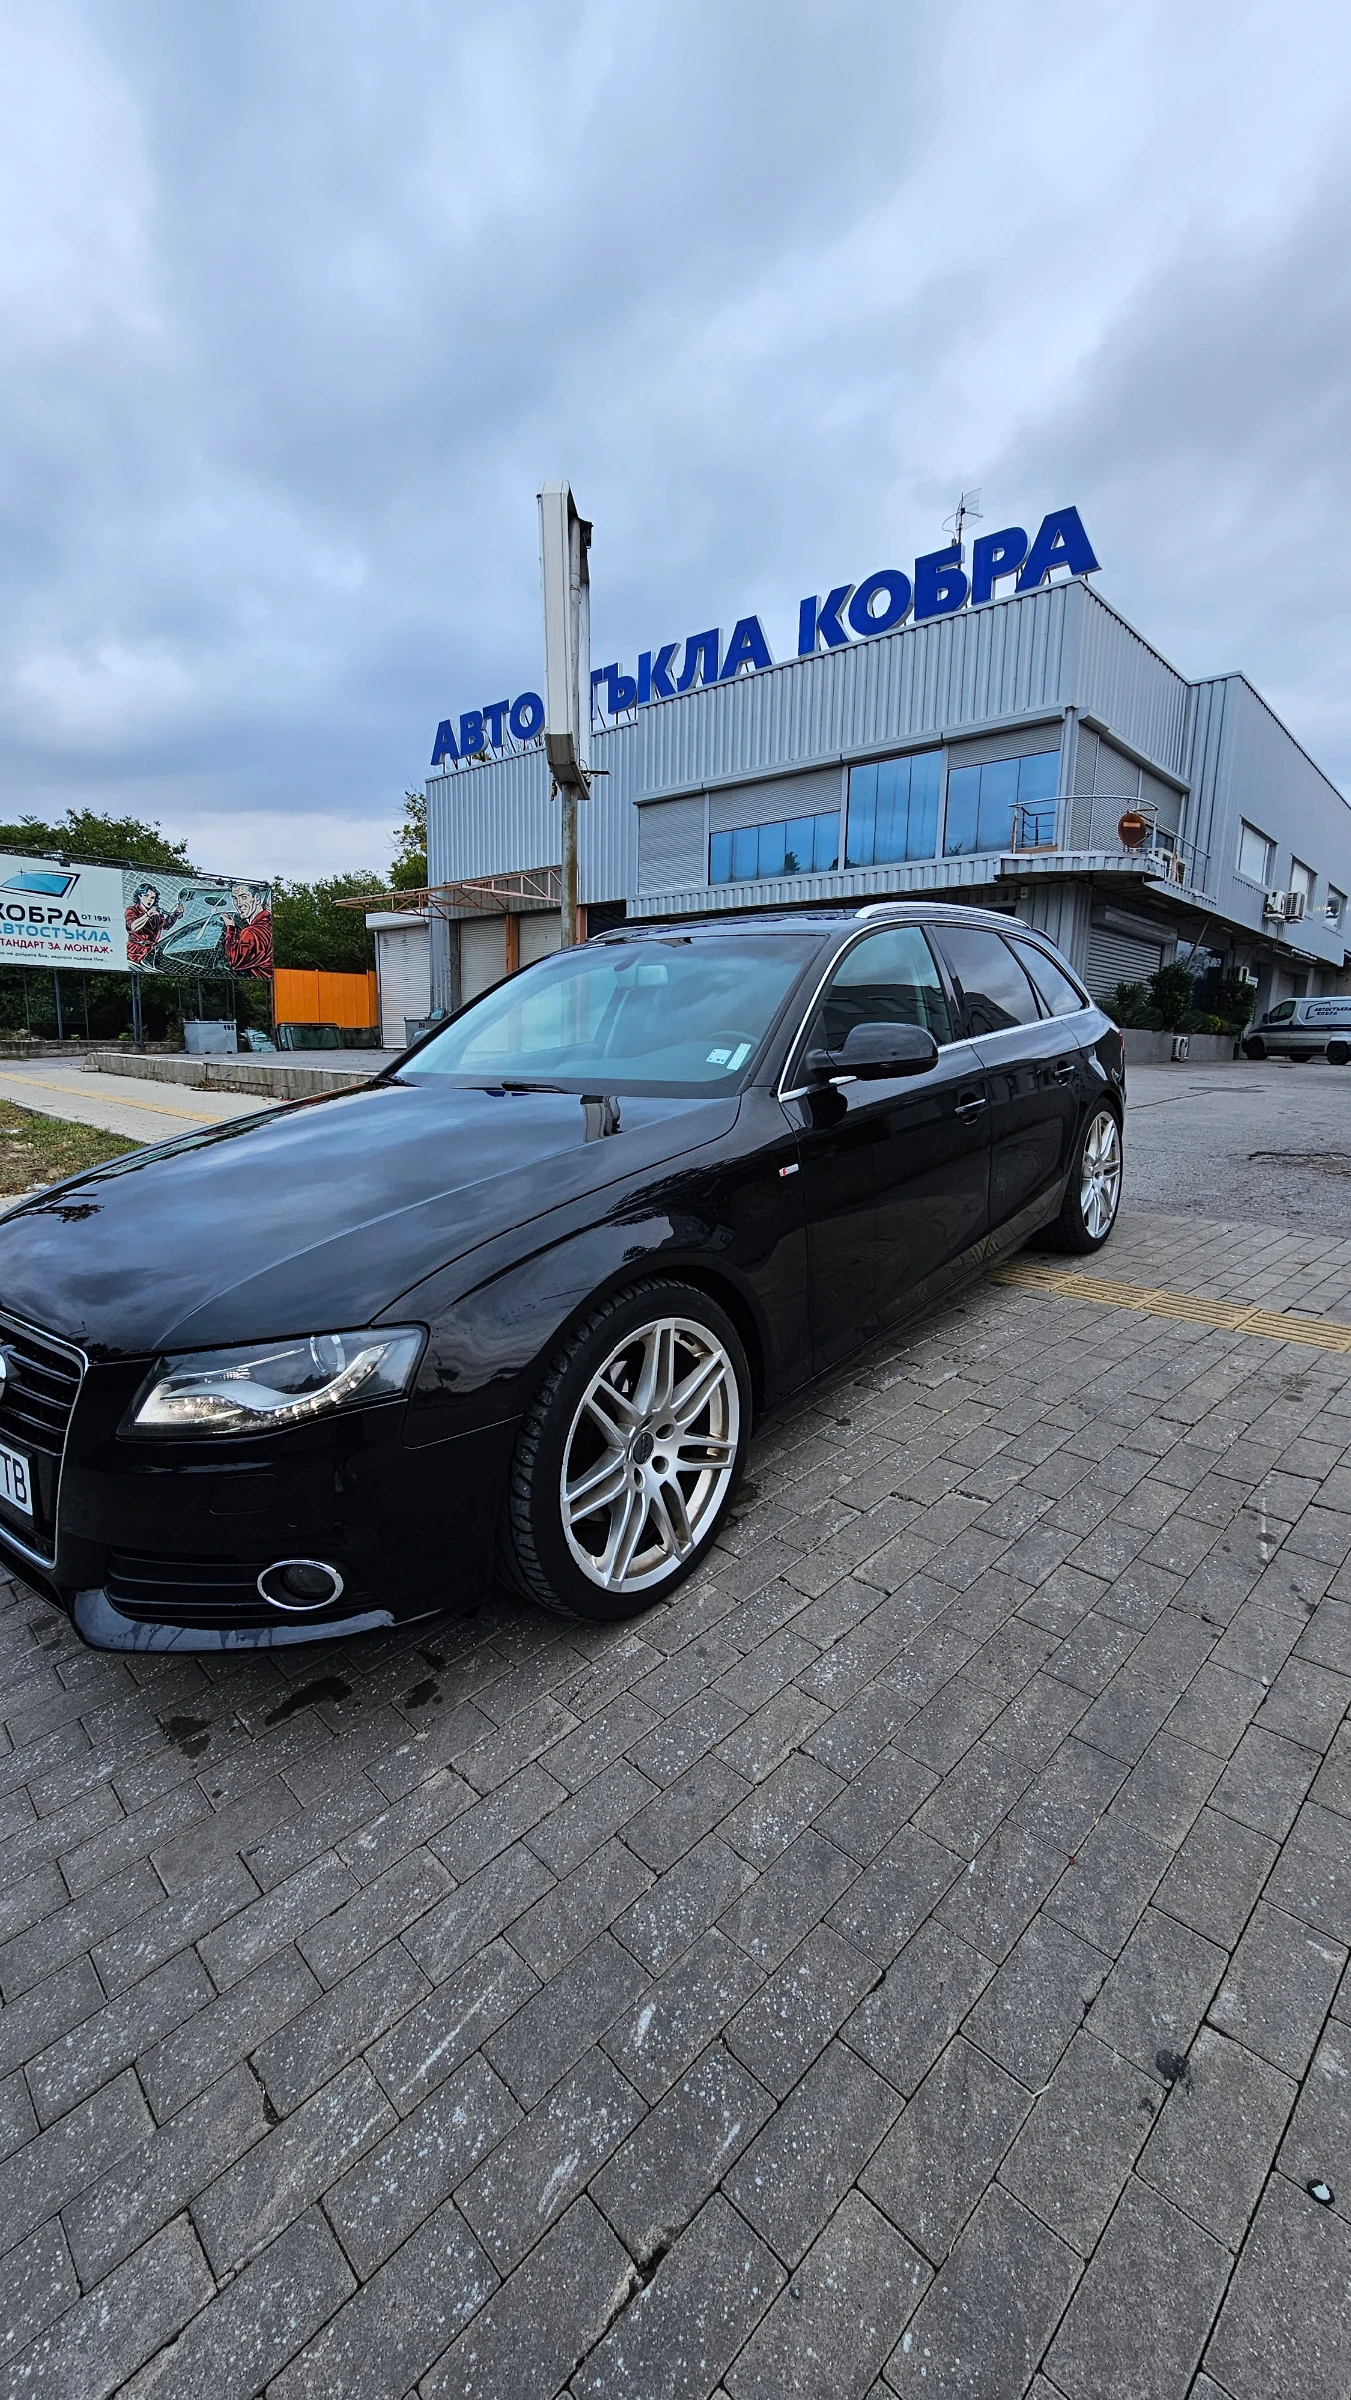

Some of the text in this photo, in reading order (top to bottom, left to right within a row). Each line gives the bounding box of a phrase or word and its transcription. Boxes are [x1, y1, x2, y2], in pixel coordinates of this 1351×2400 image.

[430, 505, 1102, 766] АВТОЪКЛА КОБРА
[0, 923, 111, 942] ВТОСТЪКЛА
[0, 938, 109, 954] ТАНДАРТ ЗА МОНТАЖ
